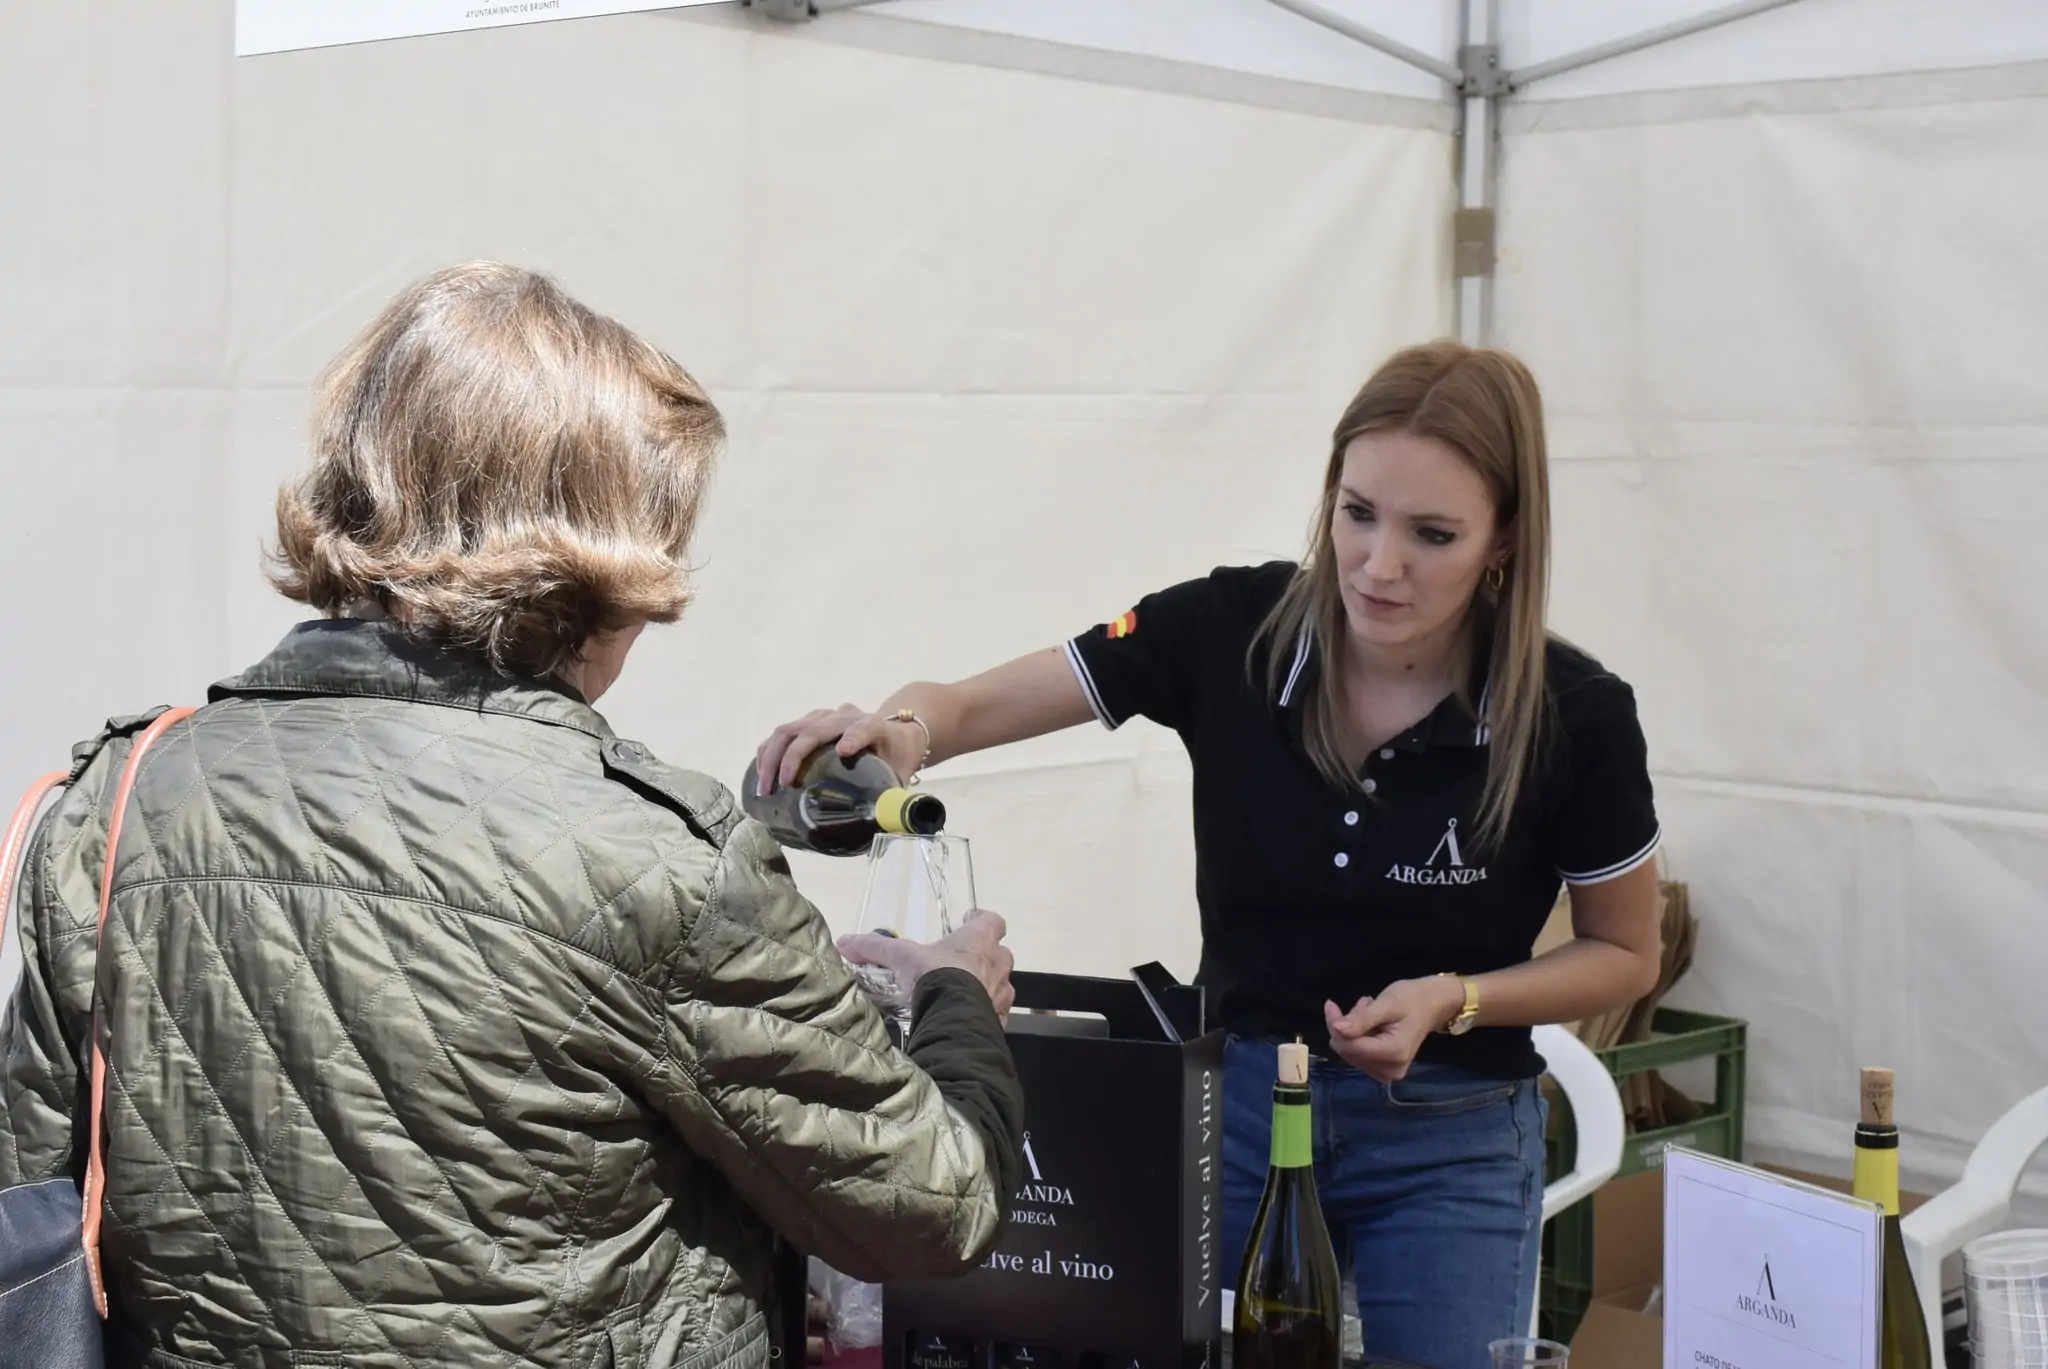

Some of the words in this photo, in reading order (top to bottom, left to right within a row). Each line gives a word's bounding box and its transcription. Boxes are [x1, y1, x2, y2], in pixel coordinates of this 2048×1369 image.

[465, 5, 518, 18] AYUNTAMIENTO
[520, 3, 528, 12] DE
[530, 1, 560, 11] BRUNETE
[1385, 863, 1488, 885] ARGANDA
[1198, 1070, 1212, 1143] vino
[1198, 1152, 1212, 1182] al
[1016, 1184, 1075, 1205] ANDA
[1032, 1251, 1052, 1274] al
[1060, 1254, 1114, 1281] vino
[1198, 1194, 1212, 1309] Vuelve
[1735, 1294, 1796, 1329] ARGANDA
[1694, 1350, 1720, 1369] CHATO
